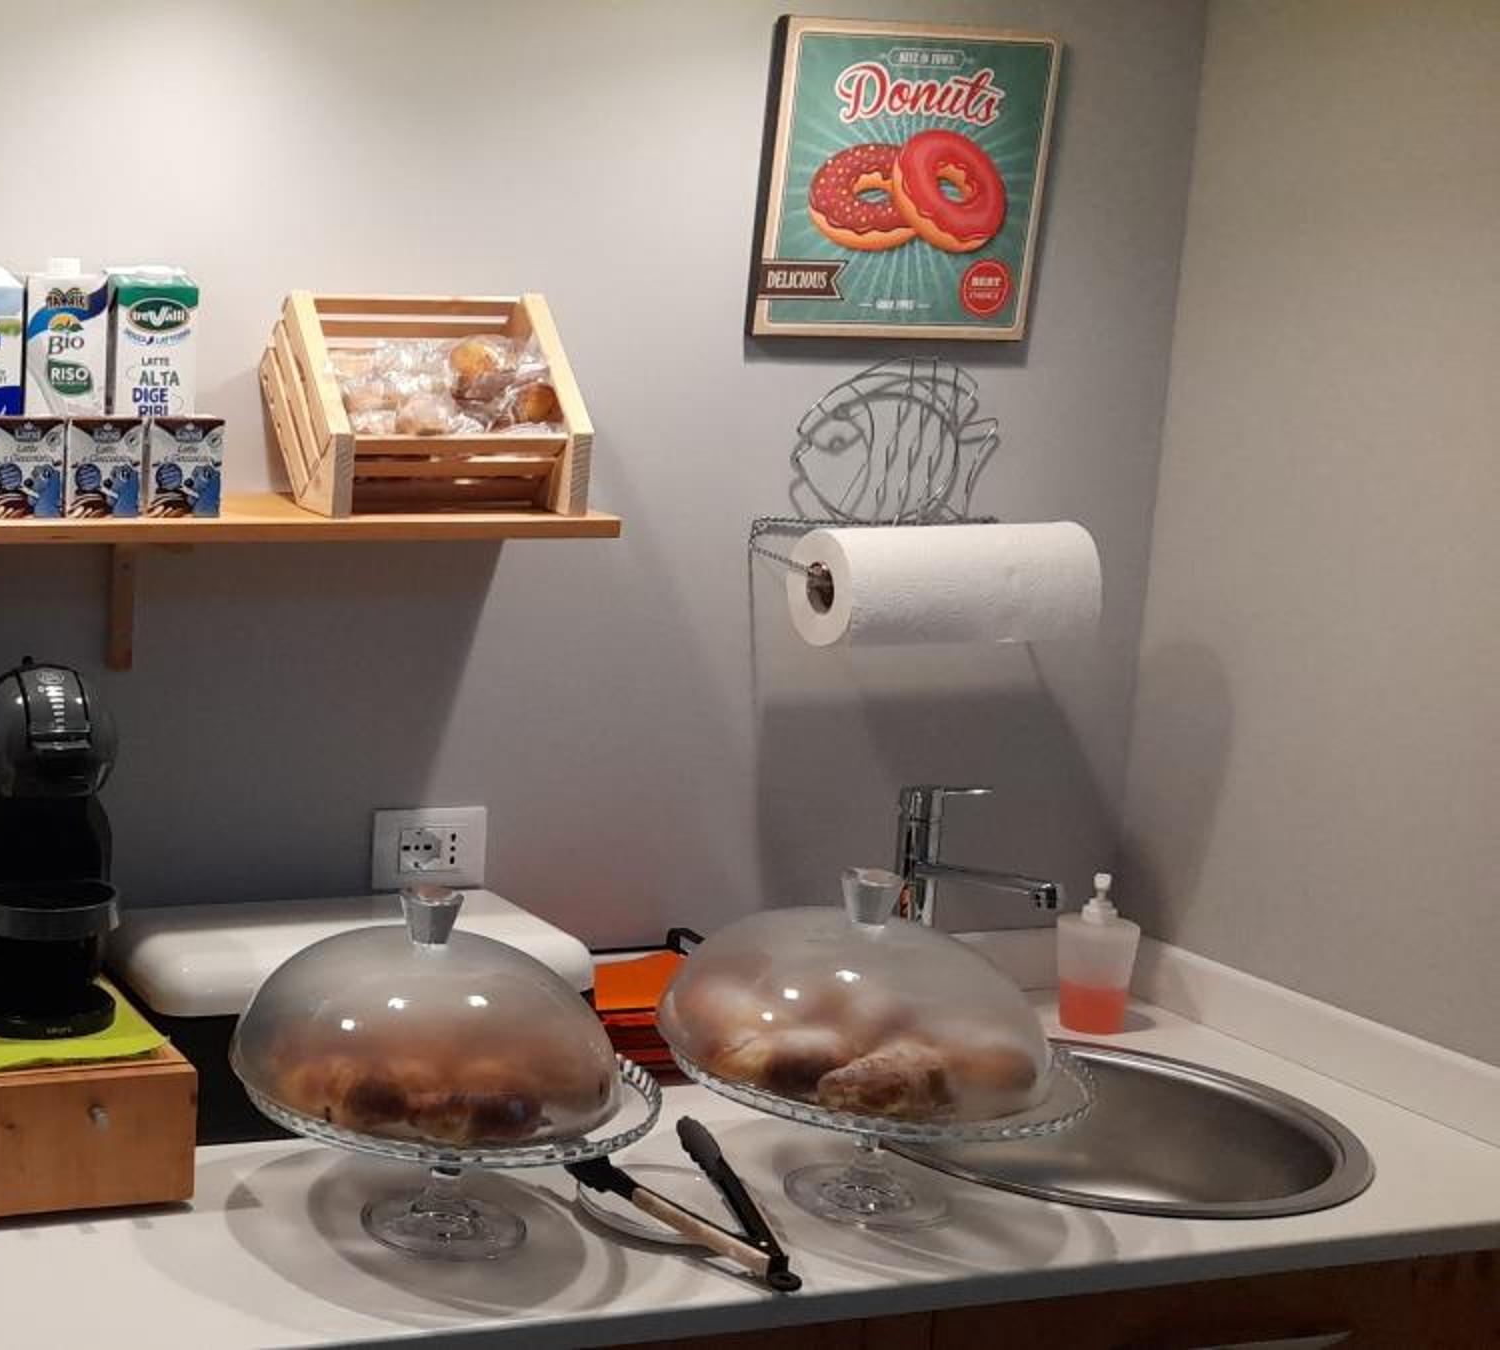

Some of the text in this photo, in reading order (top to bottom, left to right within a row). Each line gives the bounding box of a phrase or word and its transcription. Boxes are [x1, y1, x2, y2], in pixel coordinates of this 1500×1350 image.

[835, 61, 1006, 127] Donuts
[766, 270, 828, 289] DELICIOUS
[48, 331, 85, 355] Bio
[141, 356, 170, 367] LATTE
[50, 367, 89, 382] RISO
[139, 371, 180, 387] ALTA
[132, 387, 169, 403] DIGE
